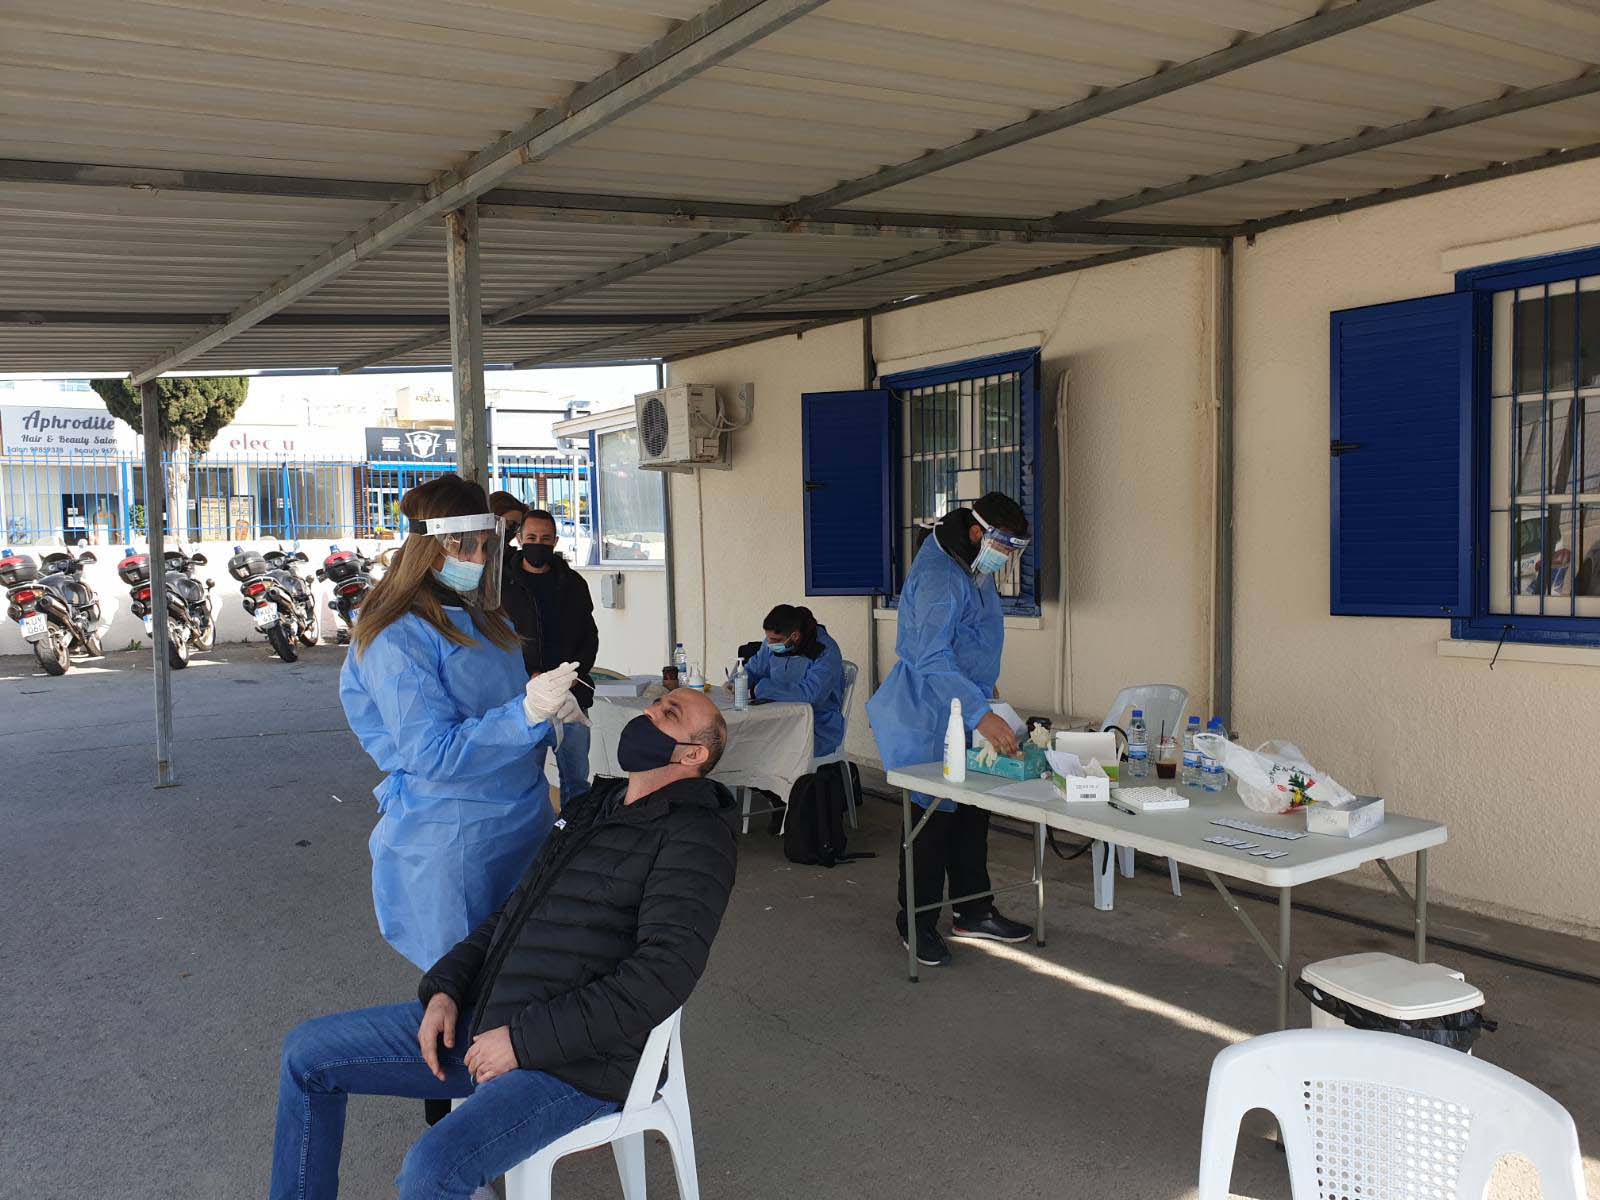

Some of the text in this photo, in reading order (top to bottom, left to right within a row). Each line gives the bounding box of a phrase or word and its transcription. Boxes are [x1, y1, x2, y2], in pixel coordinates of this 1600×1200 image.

[22, 410, 115, 432] Aphrodite
[21, 434, 42, 443] Hair
[59, 435, 89, 445] Beauty
[93, 436, 117, 445] Salon
